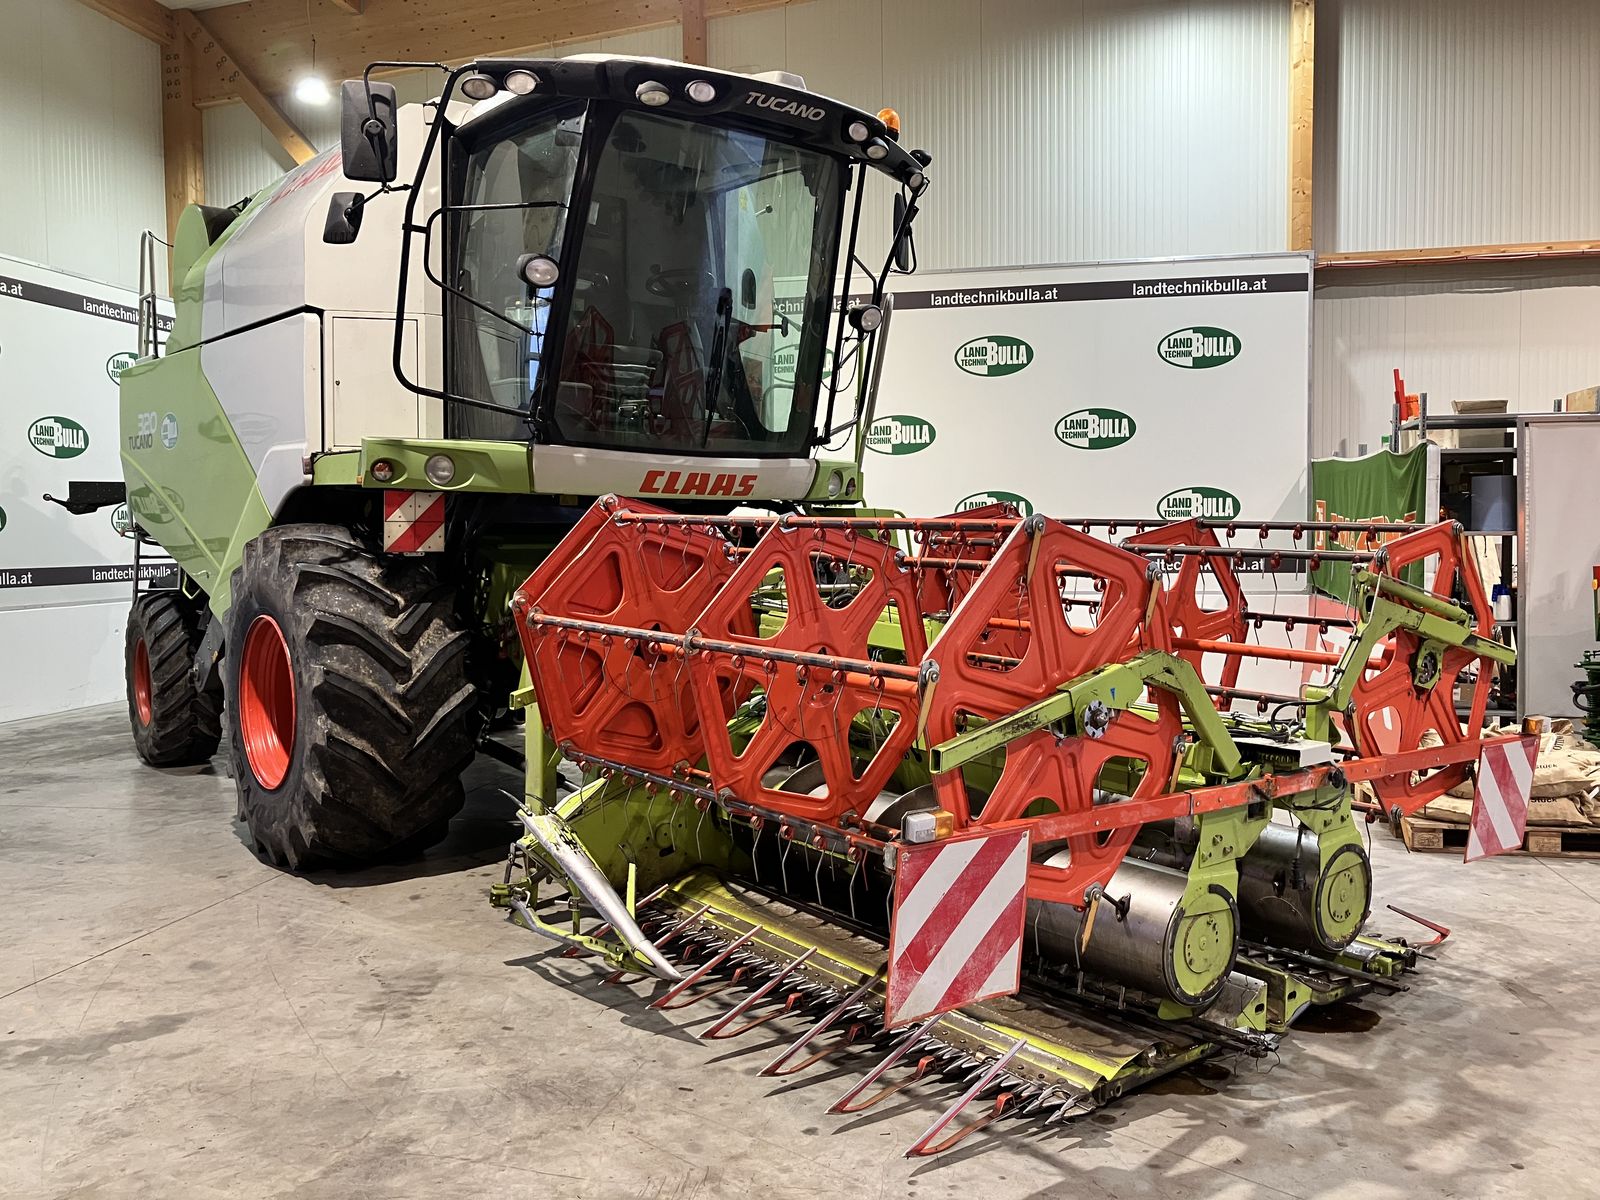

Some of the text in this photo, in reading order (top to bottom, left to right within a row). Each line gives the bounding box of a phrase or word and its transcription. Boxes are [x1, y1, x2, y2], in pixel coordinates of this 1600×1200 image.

[745, 91, 826, 121] TUCANO
[1132, 278, 1267, 296] landtechnikbulla.at
[930, 287, 1058, 306] landtechnikbulla.at
[964, 341, 1027, 366] LAND BULLA
[1164, 350, 1193, 358] TECHNIK
[1167, 333, 1235, 358] LAND BULLA
[961, 358, 988, 367] TECHNIK
[35, 421, 86, 449] LAND BULLA
[869, 420, 931, 445] LAND BULLA
[1061, 431, 1089, 439] TECHNIK
[1064, 414, 1130, 439] LAND BULLA
[33, 436, 56, 447] TECHNIK
[128, 433, 153, 450] TUCANO
[866, 437, 892, 445] TECHNIK
[638, 470, 758, 497] CLAAS
[1163, 509, 1192, 518] TECHNIK
[1166, 493, 1234, 518] LAND BULLA
[117, 510, 129, 520] LAN
